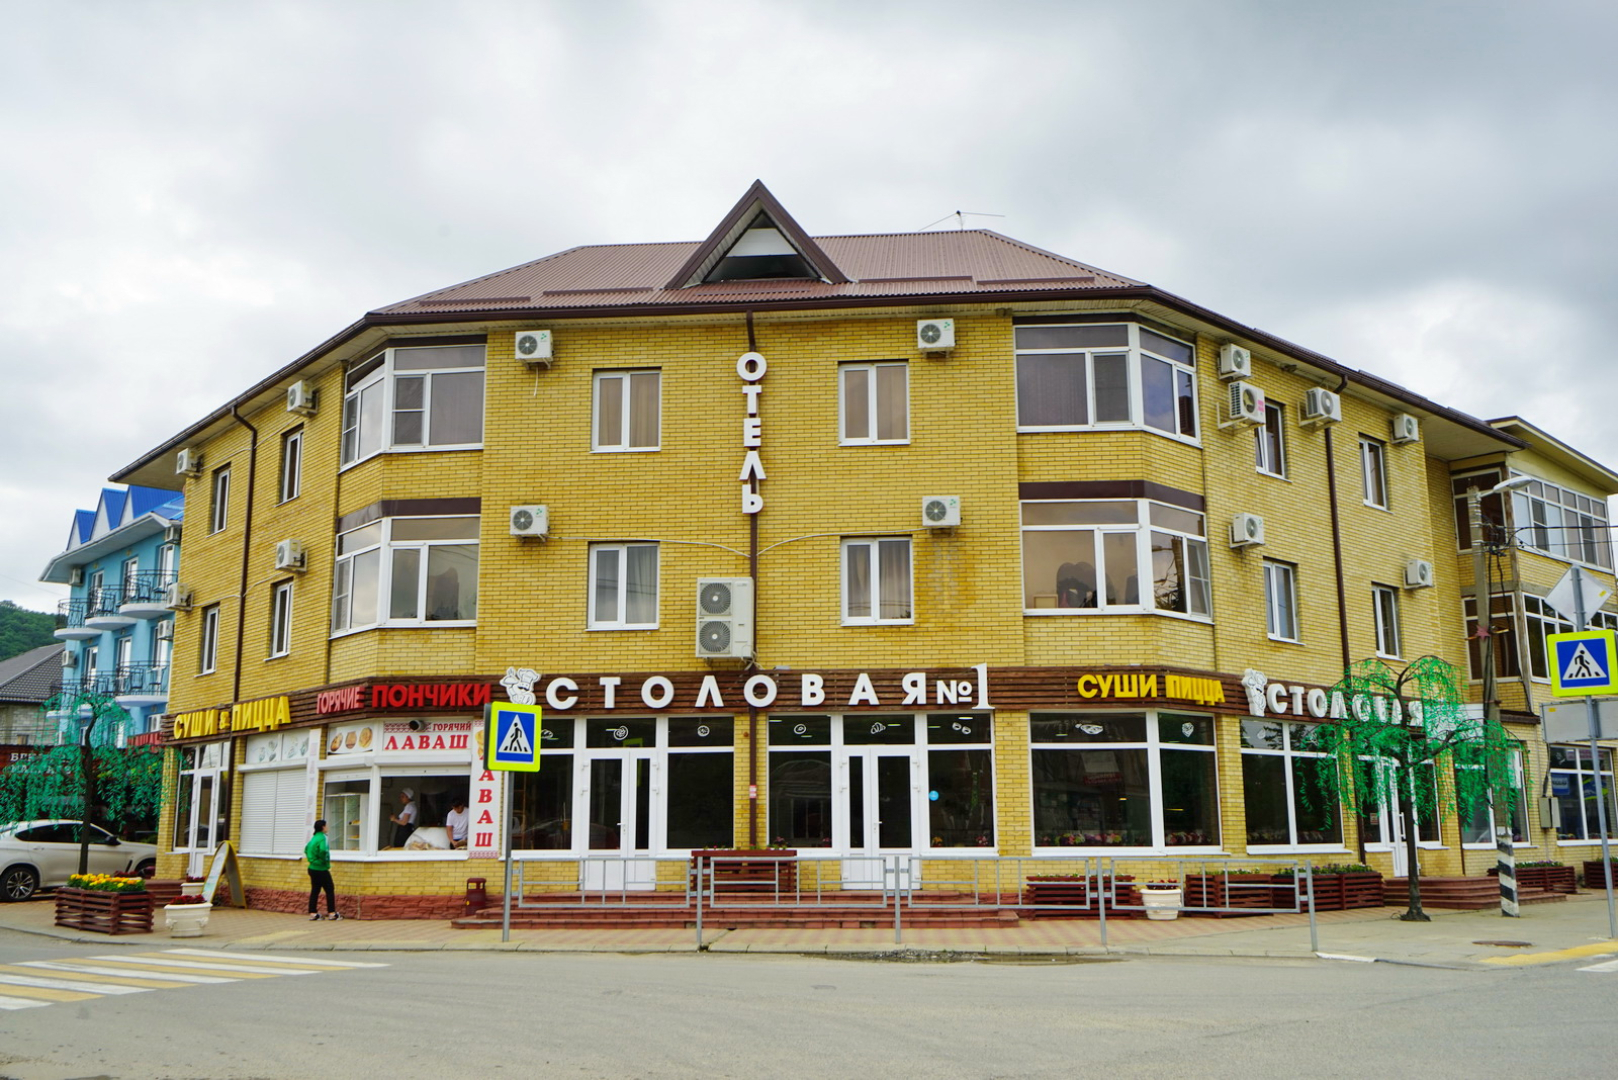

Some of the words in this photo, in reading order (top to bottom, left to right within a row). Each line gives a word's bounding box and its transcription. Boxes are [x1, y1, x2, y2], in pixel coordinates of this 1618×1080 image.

[736, 351, 768, 514] ОТЕЛЬ
[316, 685, 368, 715] ГОРЯЧИЕ
[371, 683, 493, 709] ПОНЧИКИ
[545, 671, 927, 711] СТОЛОВАЯ
[1076, 673, 1158, 699] СУШИ
[1165, 674, 1226, 706] ПИЦЦА
[173, 708, 221, 740] СУШИ
[231, 695, 292, 733] ПИЦЦА
[432, 720, 472, 732] ГОРЯЧИЙ
[384, 734, 470, 751] ЛАВАШ
[474, 754, 496, 848] АВАШ
